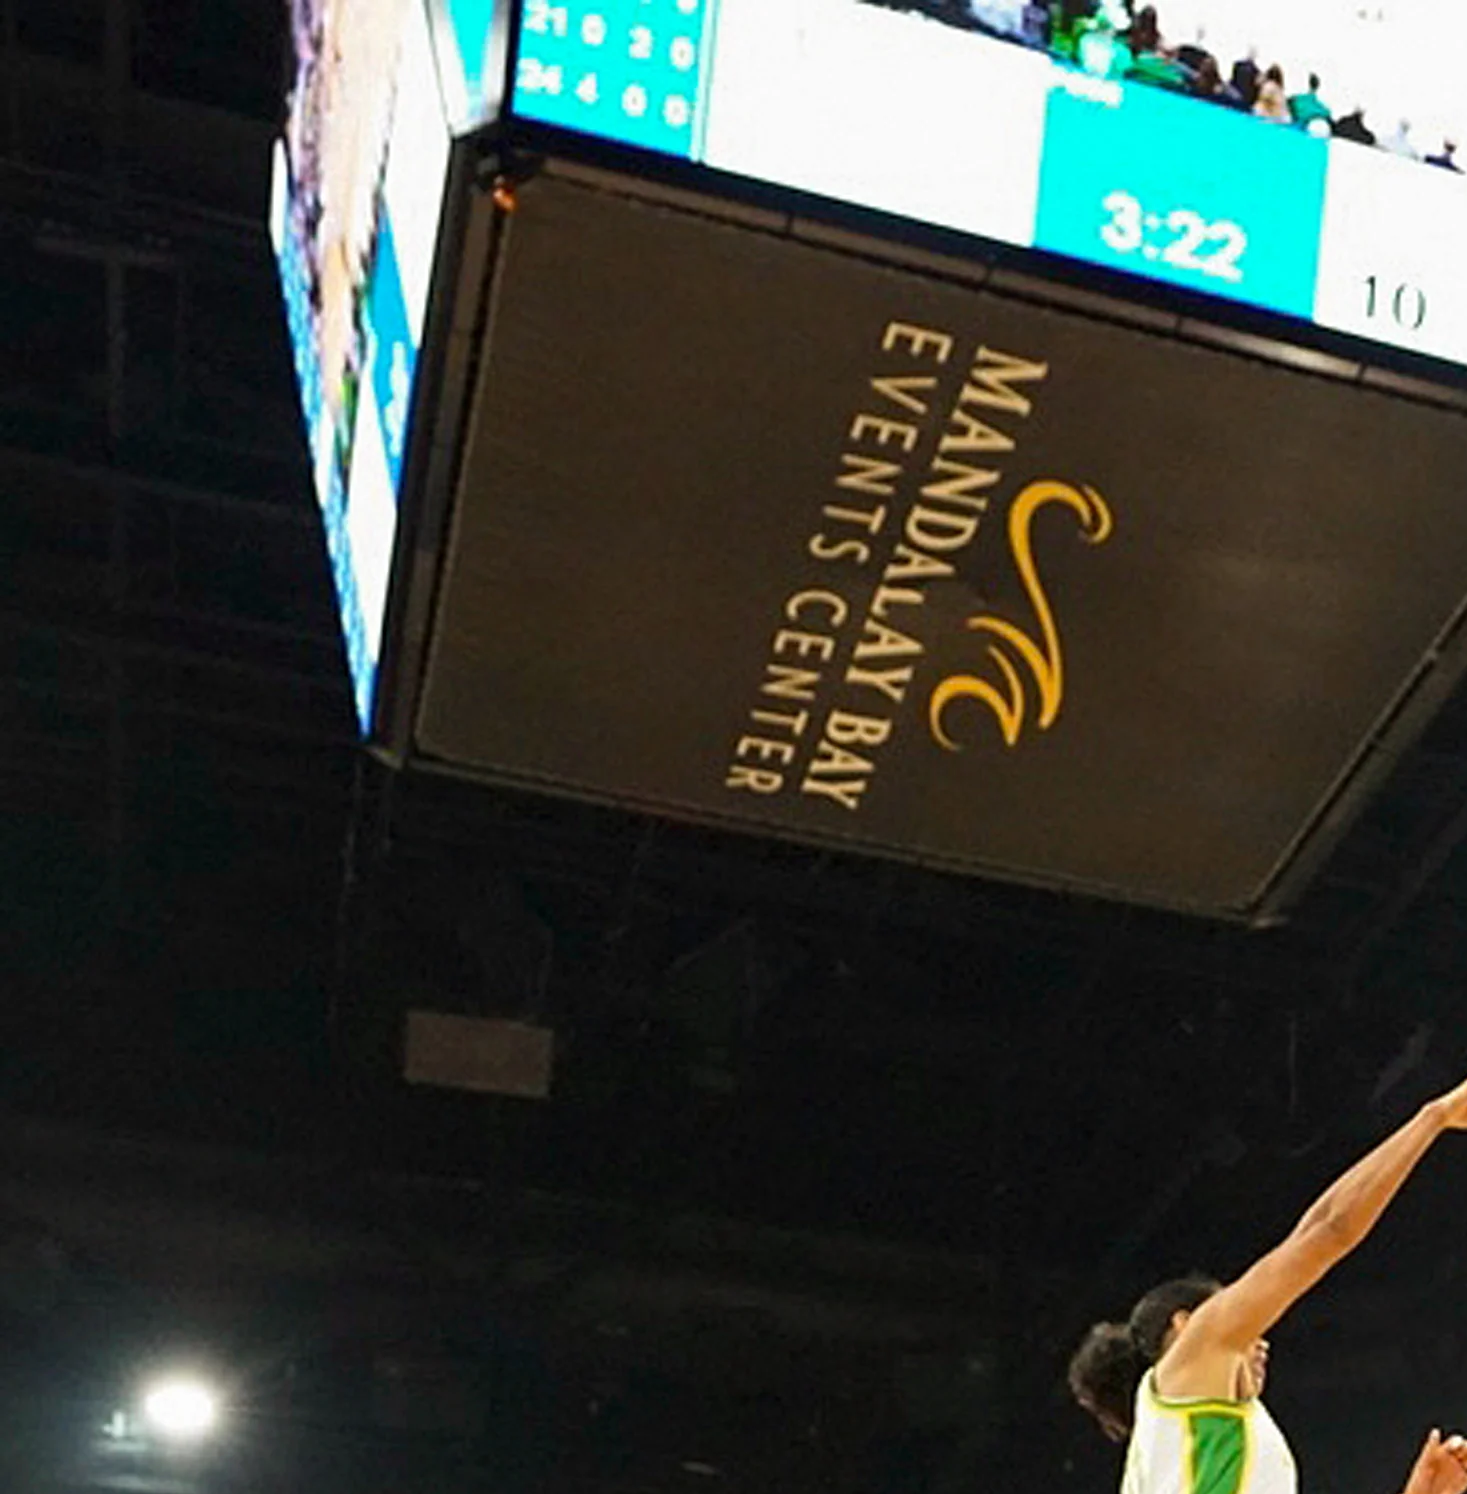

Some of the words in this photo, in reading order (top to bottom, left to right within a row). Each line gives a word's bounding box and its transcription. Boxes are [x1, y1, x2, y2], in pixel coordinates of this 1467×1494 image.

[621, 83, 647, 117] 0
[669, 36, 695, 71] 0
[1100, 189, 1247, 283] 3:22
[1363, 275, 1427, 331] 10
[808, 320, 954, 565] EVENTS
[846, 345, 1050, 703] MANDALAY
[725, 589, 848, 795] CENTER
[801, 709, 893, 811] BAY
